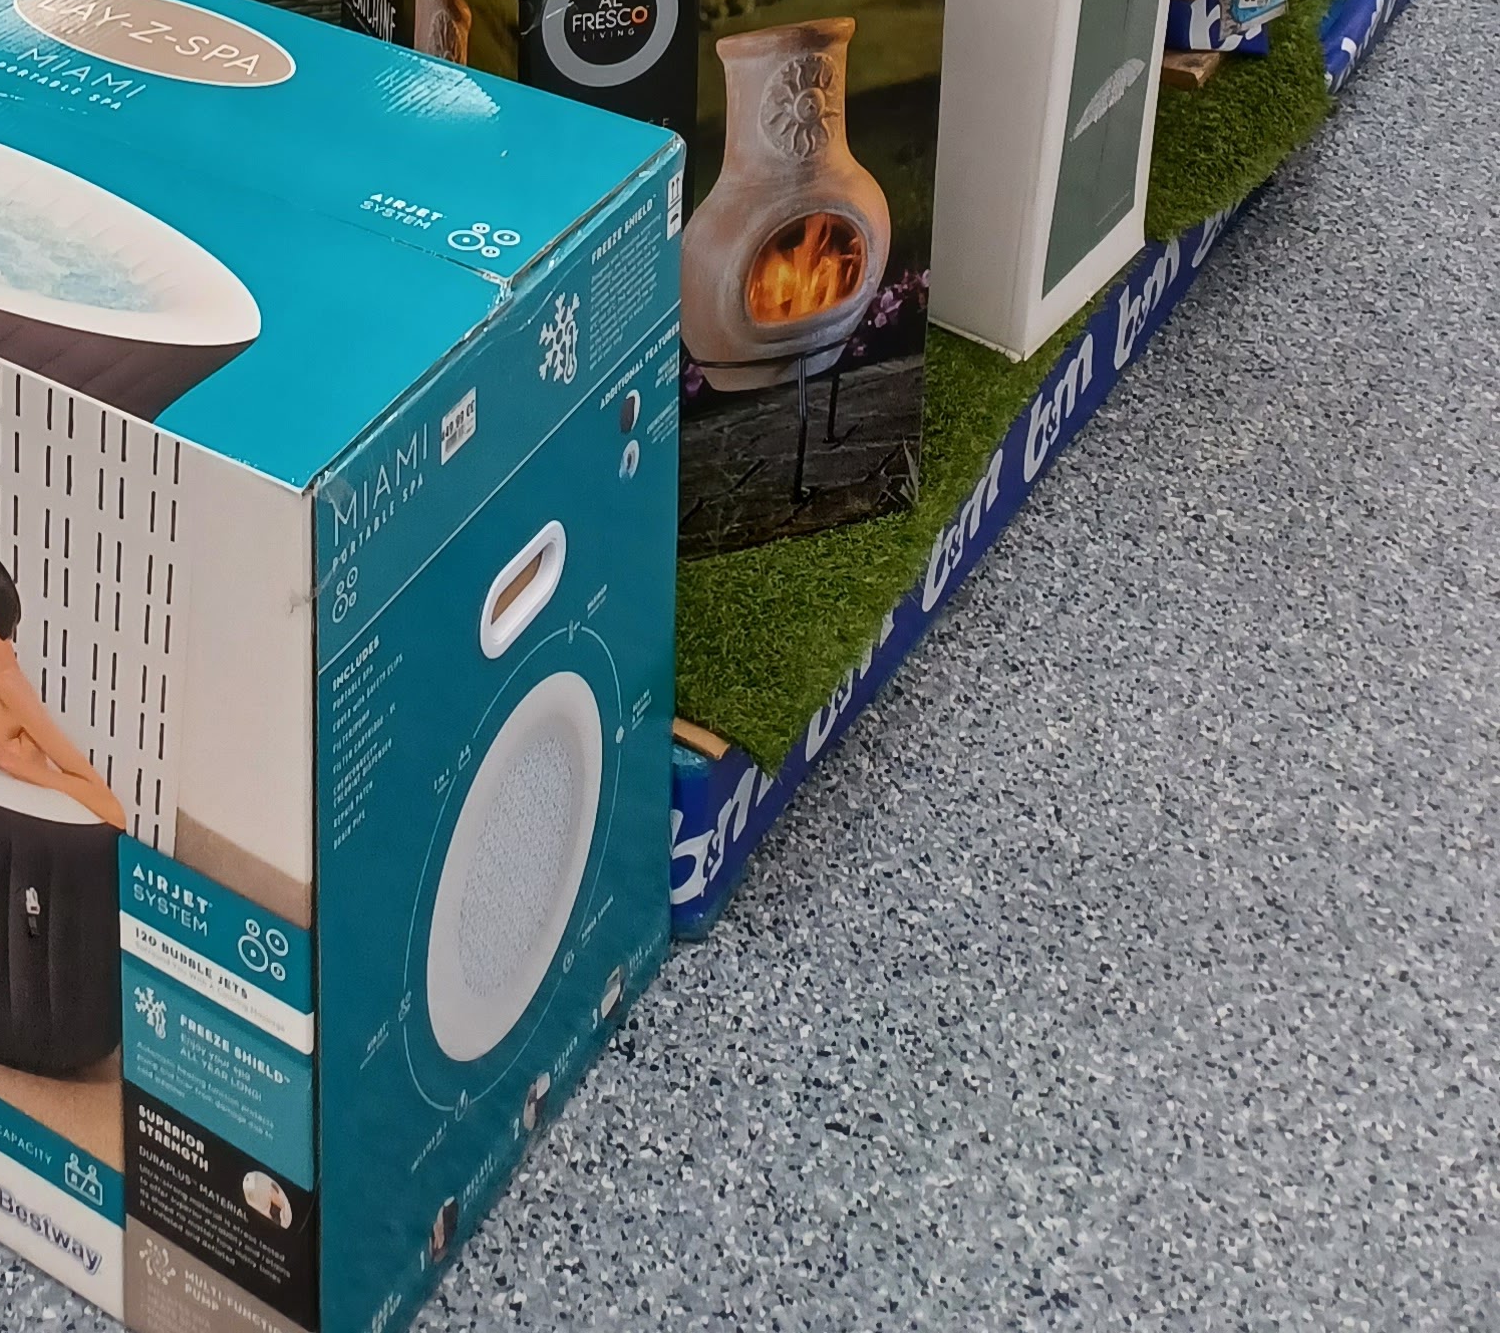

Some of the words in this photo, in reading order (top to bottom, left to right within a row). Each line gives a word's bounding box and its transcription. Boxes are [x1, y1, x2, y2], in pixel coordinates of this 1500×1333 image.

[572, 6, 648, 32] FRESCO
[582, 28, 635, 42] LIVING
[17, 48, 147, 99] MIAMI
[89, 93, 122, 110] SPA
[360, 200, 431, 230] SYSTEM
[370, 193, 444, 221] AIRJET
[591, 229, 621, 265] FREEZE
[599, 358, 644, 411] ADDITIONAL
[645, 321, 680, 364] FEATURES
[329, 422, 428, 546] MIAMI
[331, 498, 396, 573] PORTABLE
[402, 473, 424, 503] SPA
[332, 635, 380, 692] INCLUDES
[132, 863, 208, 915] AIRJET
[133, 884, 209, 937] SYSTEM
[135, 927, 157, 947] 120
[161, 941, 213, 981] BUBBLE
[218, 975, 249, 1000] JETS
[180, 1014, 230, 1053] FREEZE
[138, 1104, 205, 1154] SUPERIOR
[138, 1119, 209, 1172] STRENGTH
[199, 1183, 249, 1223] MATERIAL
